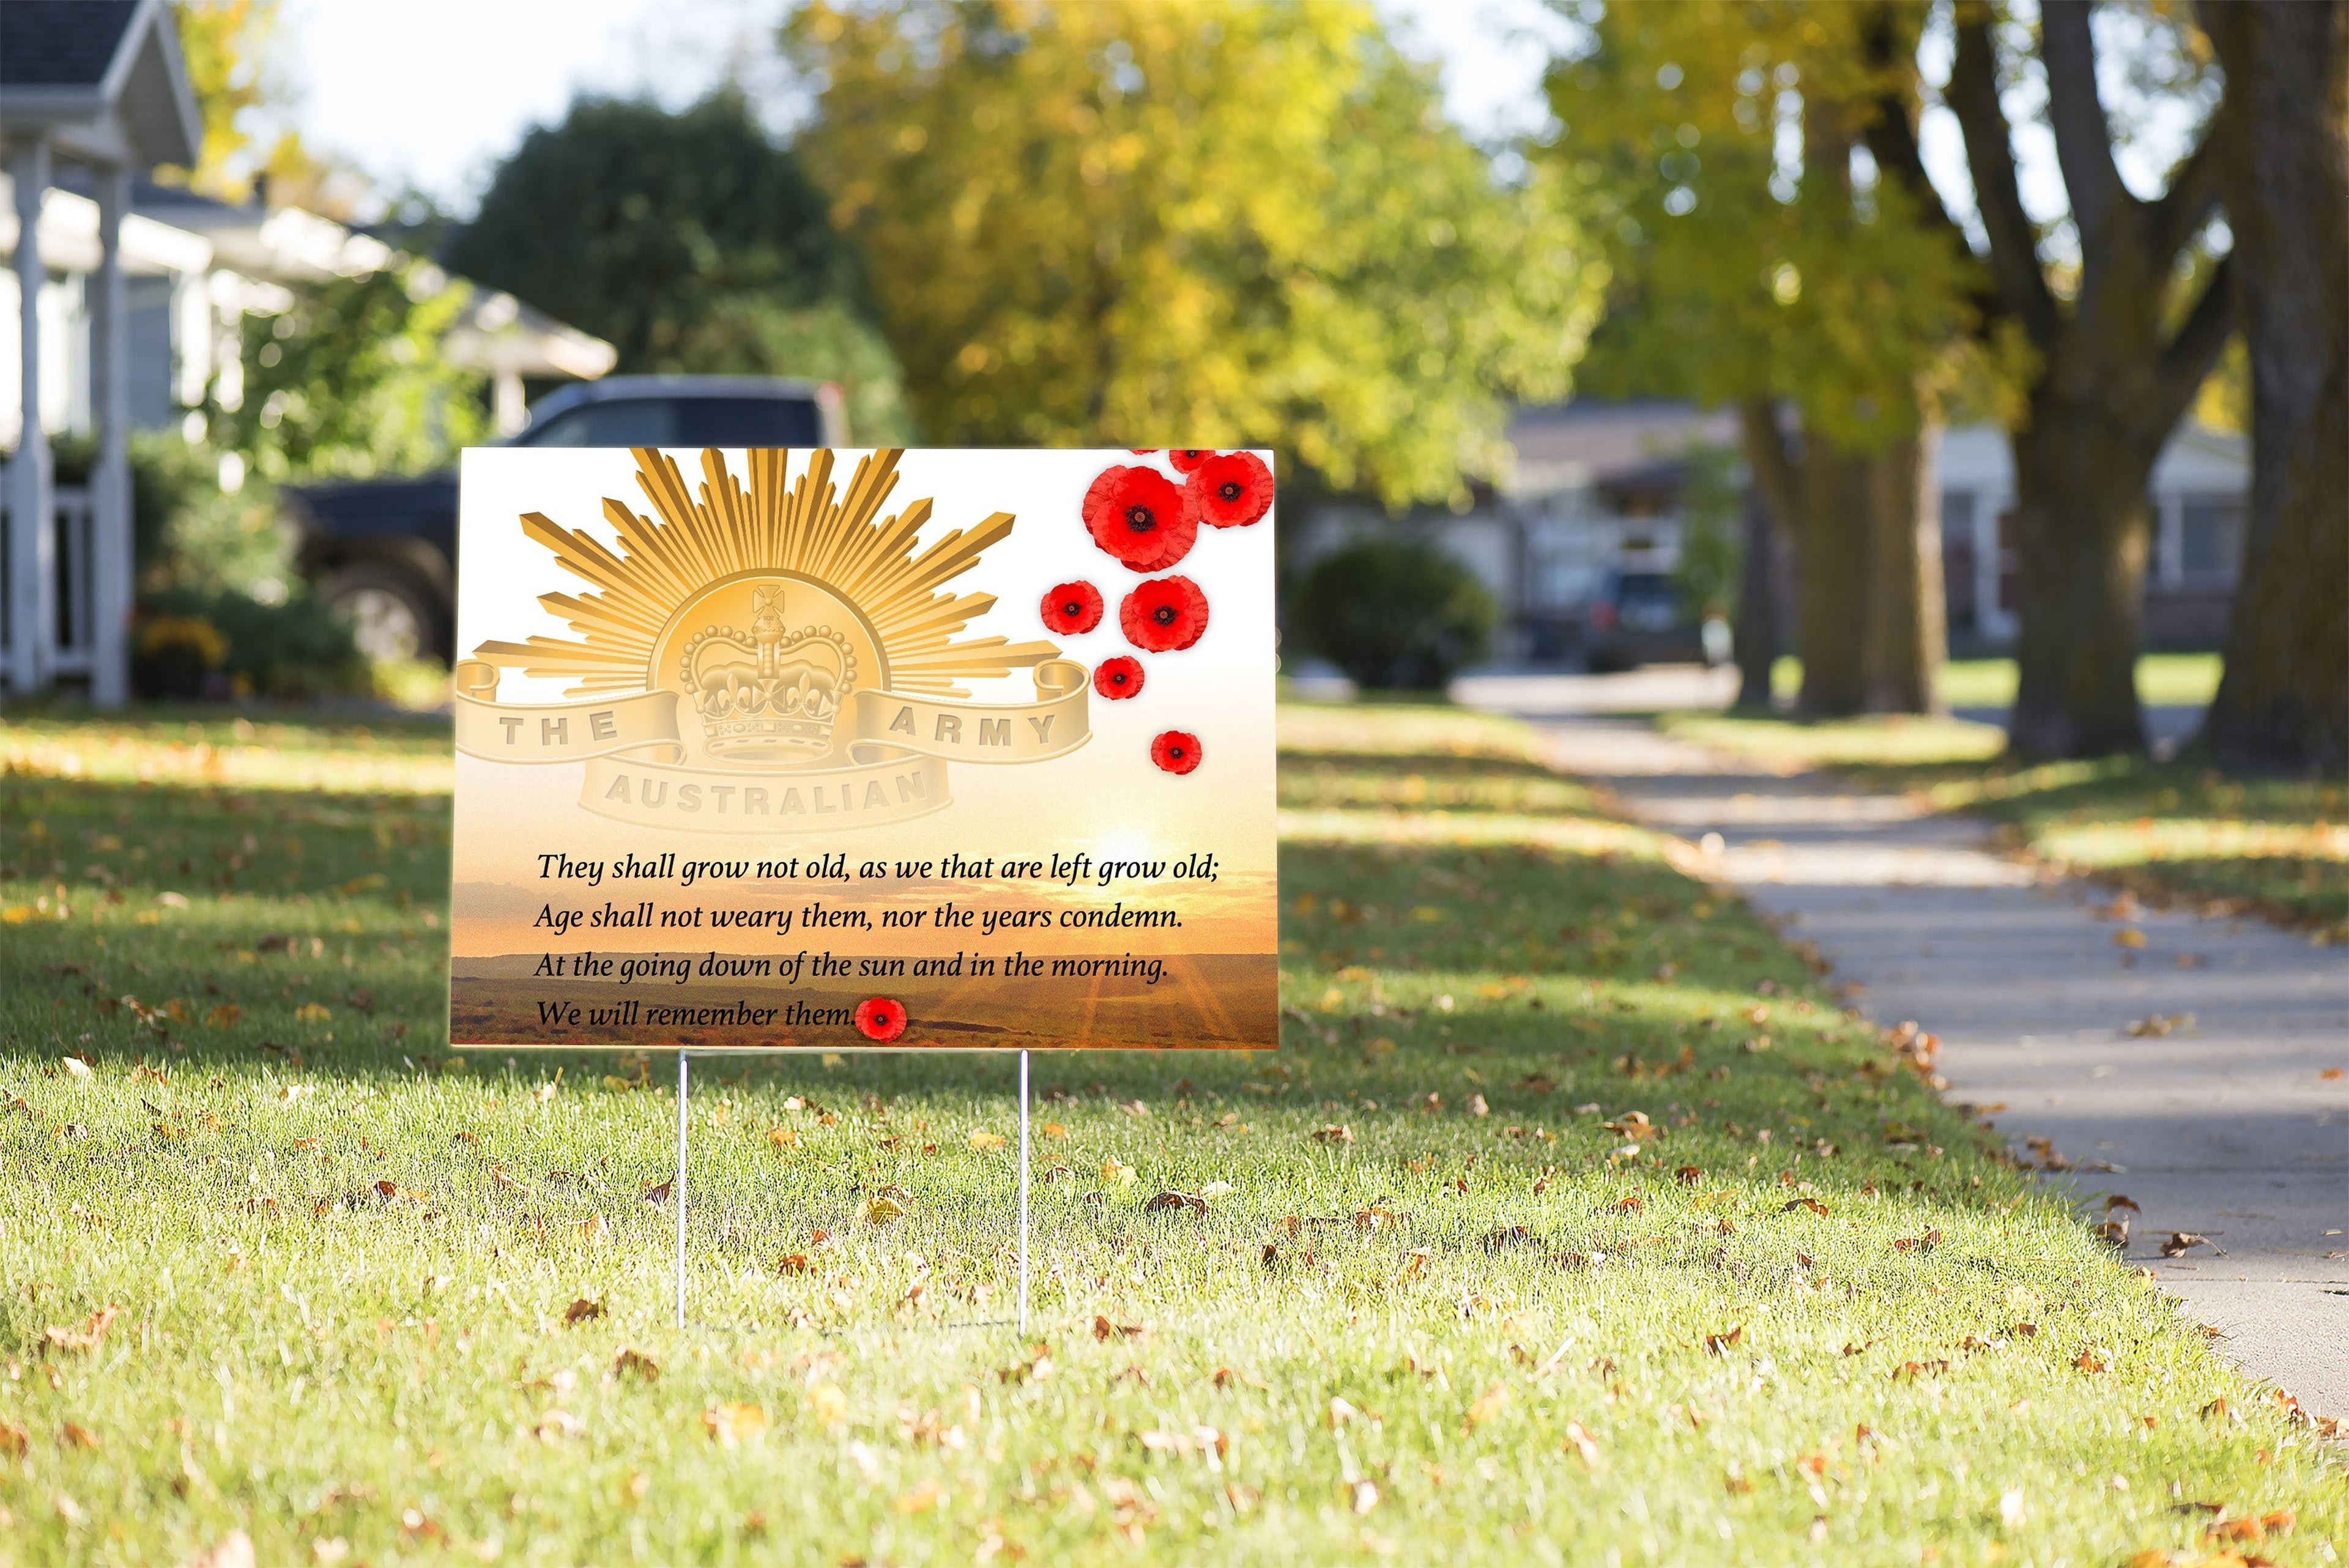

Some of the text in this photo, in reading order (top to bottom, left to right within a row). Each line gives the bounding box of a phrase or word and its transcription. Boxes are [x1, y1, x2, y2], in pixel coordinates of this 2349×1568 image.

[499, 711, 617, 745] THE
[889, 706, 1056, 746] ARMY
[604, 771, 926, 816] AUSTRALIAN
[538, 852, 1219, 887] They shall grow not old, as we that are left grow old;
[533, 902, 1182, 936] Age shall not weary them, nor the years condemn.
[533, 950, 1167, 985] At the going down of the sun and in the morning.
[537, 1000, 856, 1026] We will remember them.
